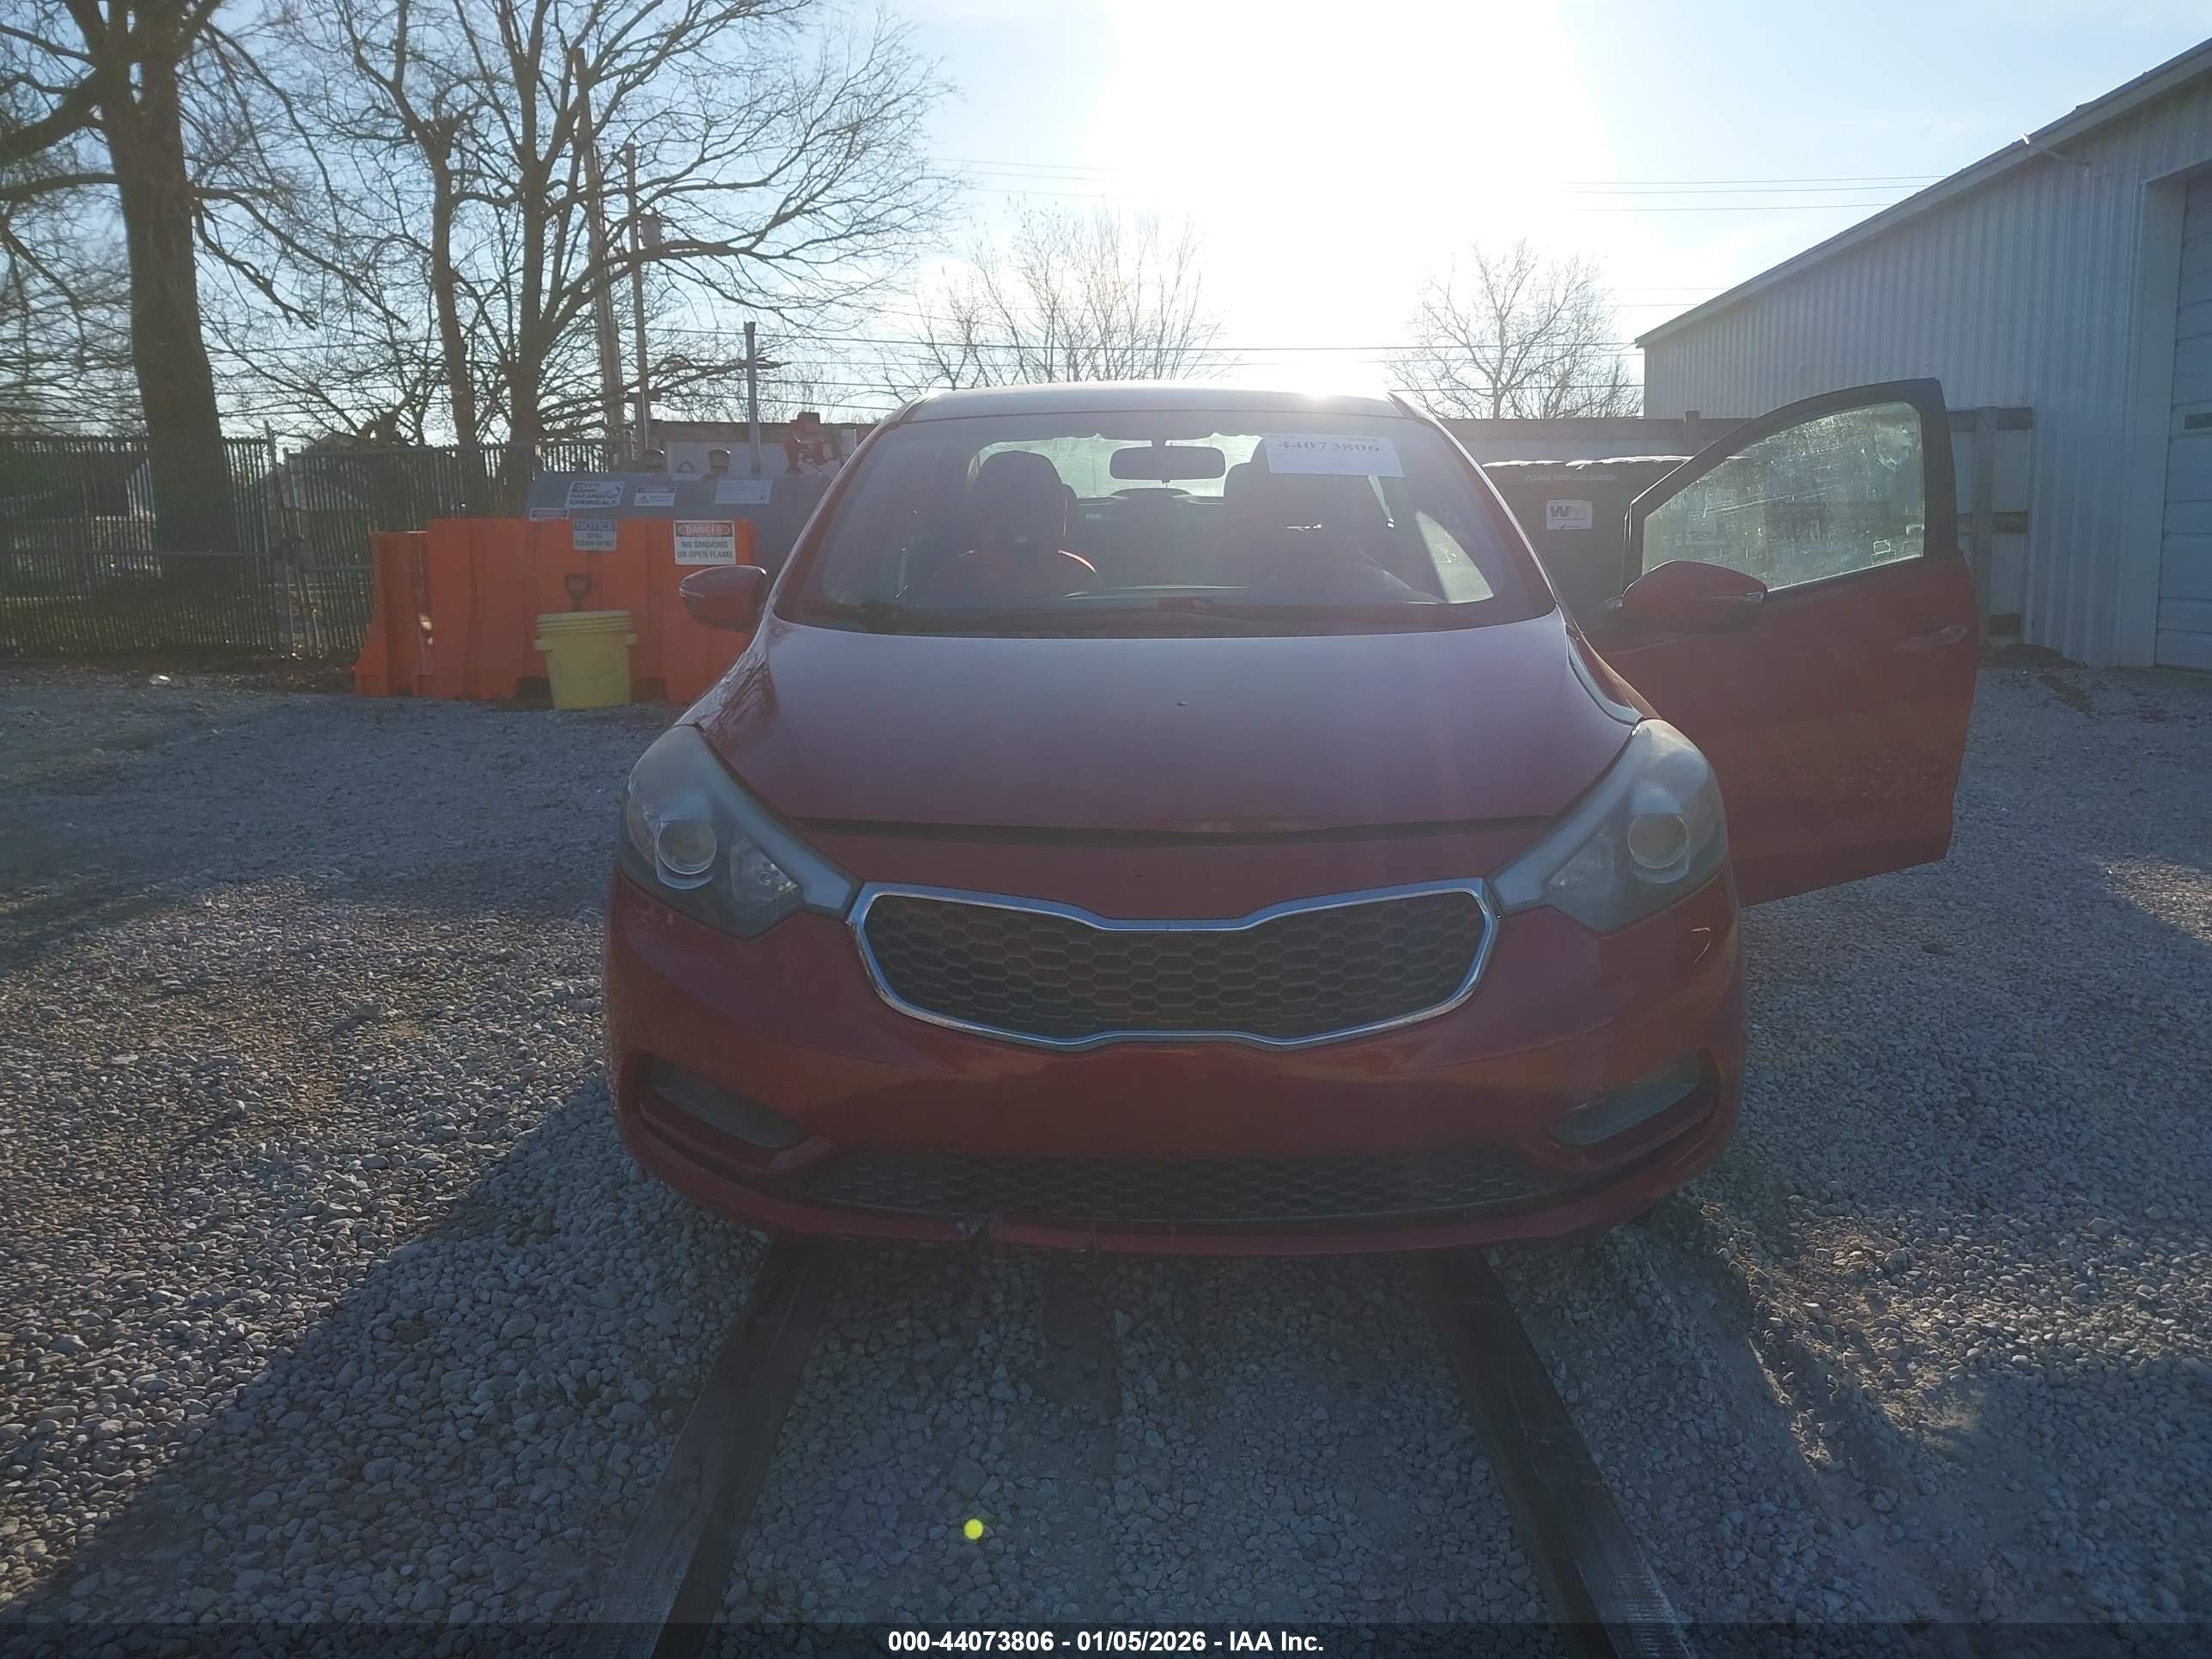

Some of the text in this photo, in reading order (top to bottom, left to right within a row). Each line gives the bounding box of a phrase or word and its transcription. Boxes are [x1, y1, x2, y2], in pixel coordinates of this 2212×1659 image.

[1279, 441, 1380, 453] 44073806
[1549, 506, 1588, 518] WM
[575, 521, 614, 531] NOTICE
[686, 525, 722, 535] DANGER
